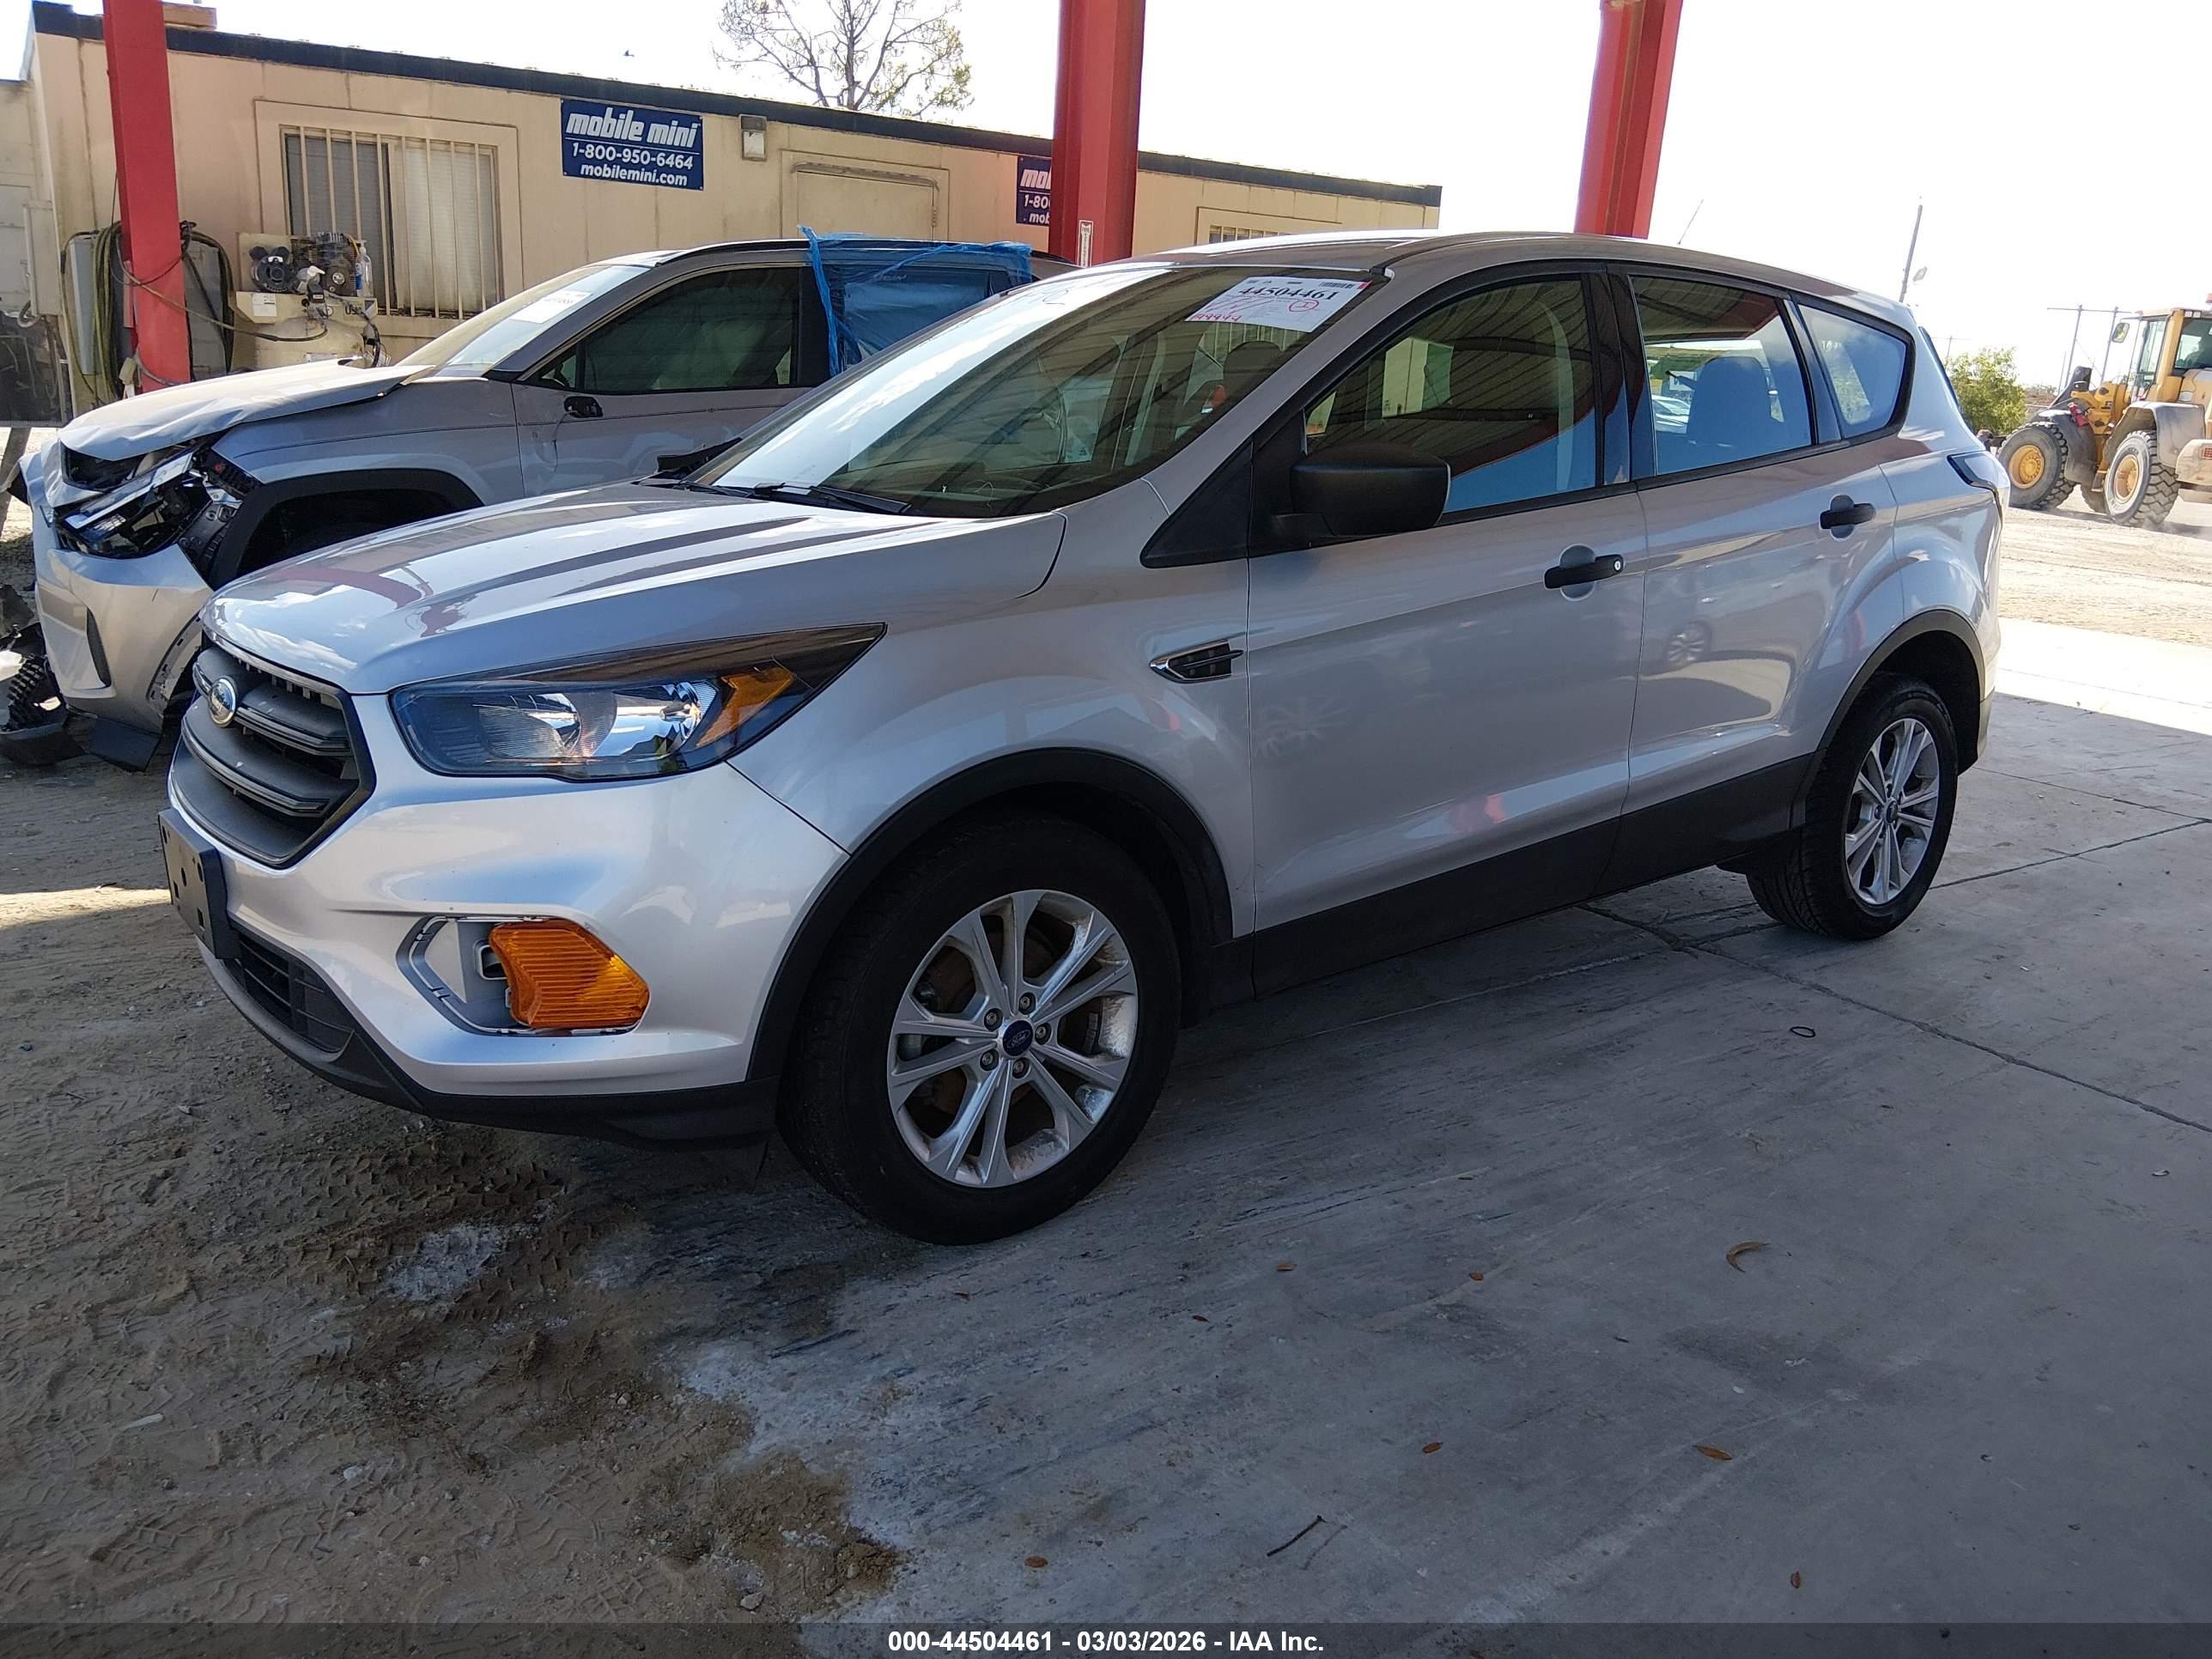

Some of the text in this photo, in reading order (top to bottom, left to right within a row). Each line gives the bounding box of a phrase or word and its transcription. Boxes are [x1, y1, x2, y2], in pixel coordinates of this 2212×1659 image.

[565, 106, 699, 148] mobile mini
[572, 143, 693, 170] 1-800-950-6464
[580, 163, 688, 186] mobilemini.com
[1024, 194, 1050, 209] 1-80
[1238, 286, 1340, 300] 44504461
